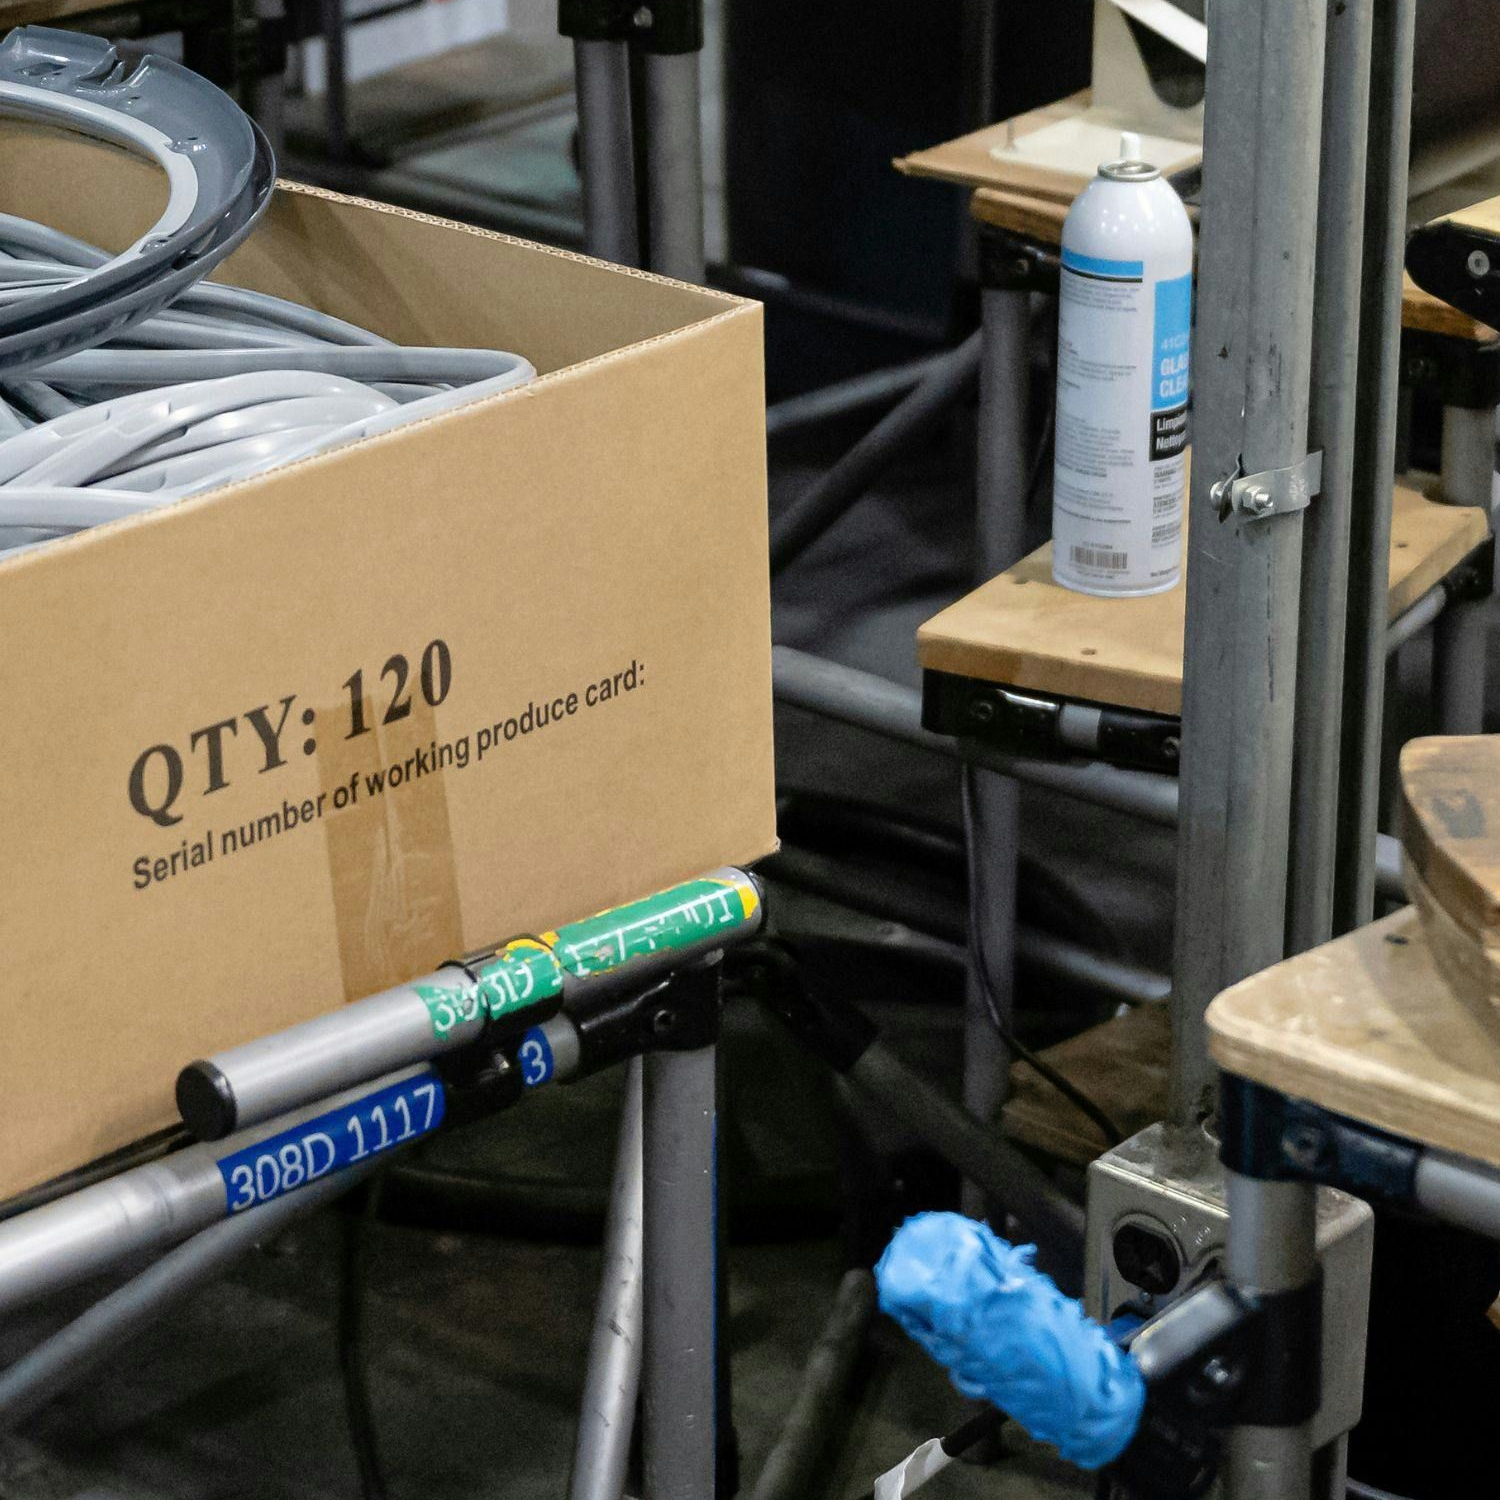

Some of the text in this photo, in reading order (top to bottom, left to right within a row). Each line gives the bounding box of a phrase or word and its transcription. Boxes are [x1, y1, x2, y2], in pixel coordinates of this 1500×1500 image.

[128, 638, 452, 828] QTY: 120
[133, 659, 646, 891] Serial number of working produce card:
[230, 1131, 336, 1212] 308D
[346, 1082, 437, 1162] 1117
